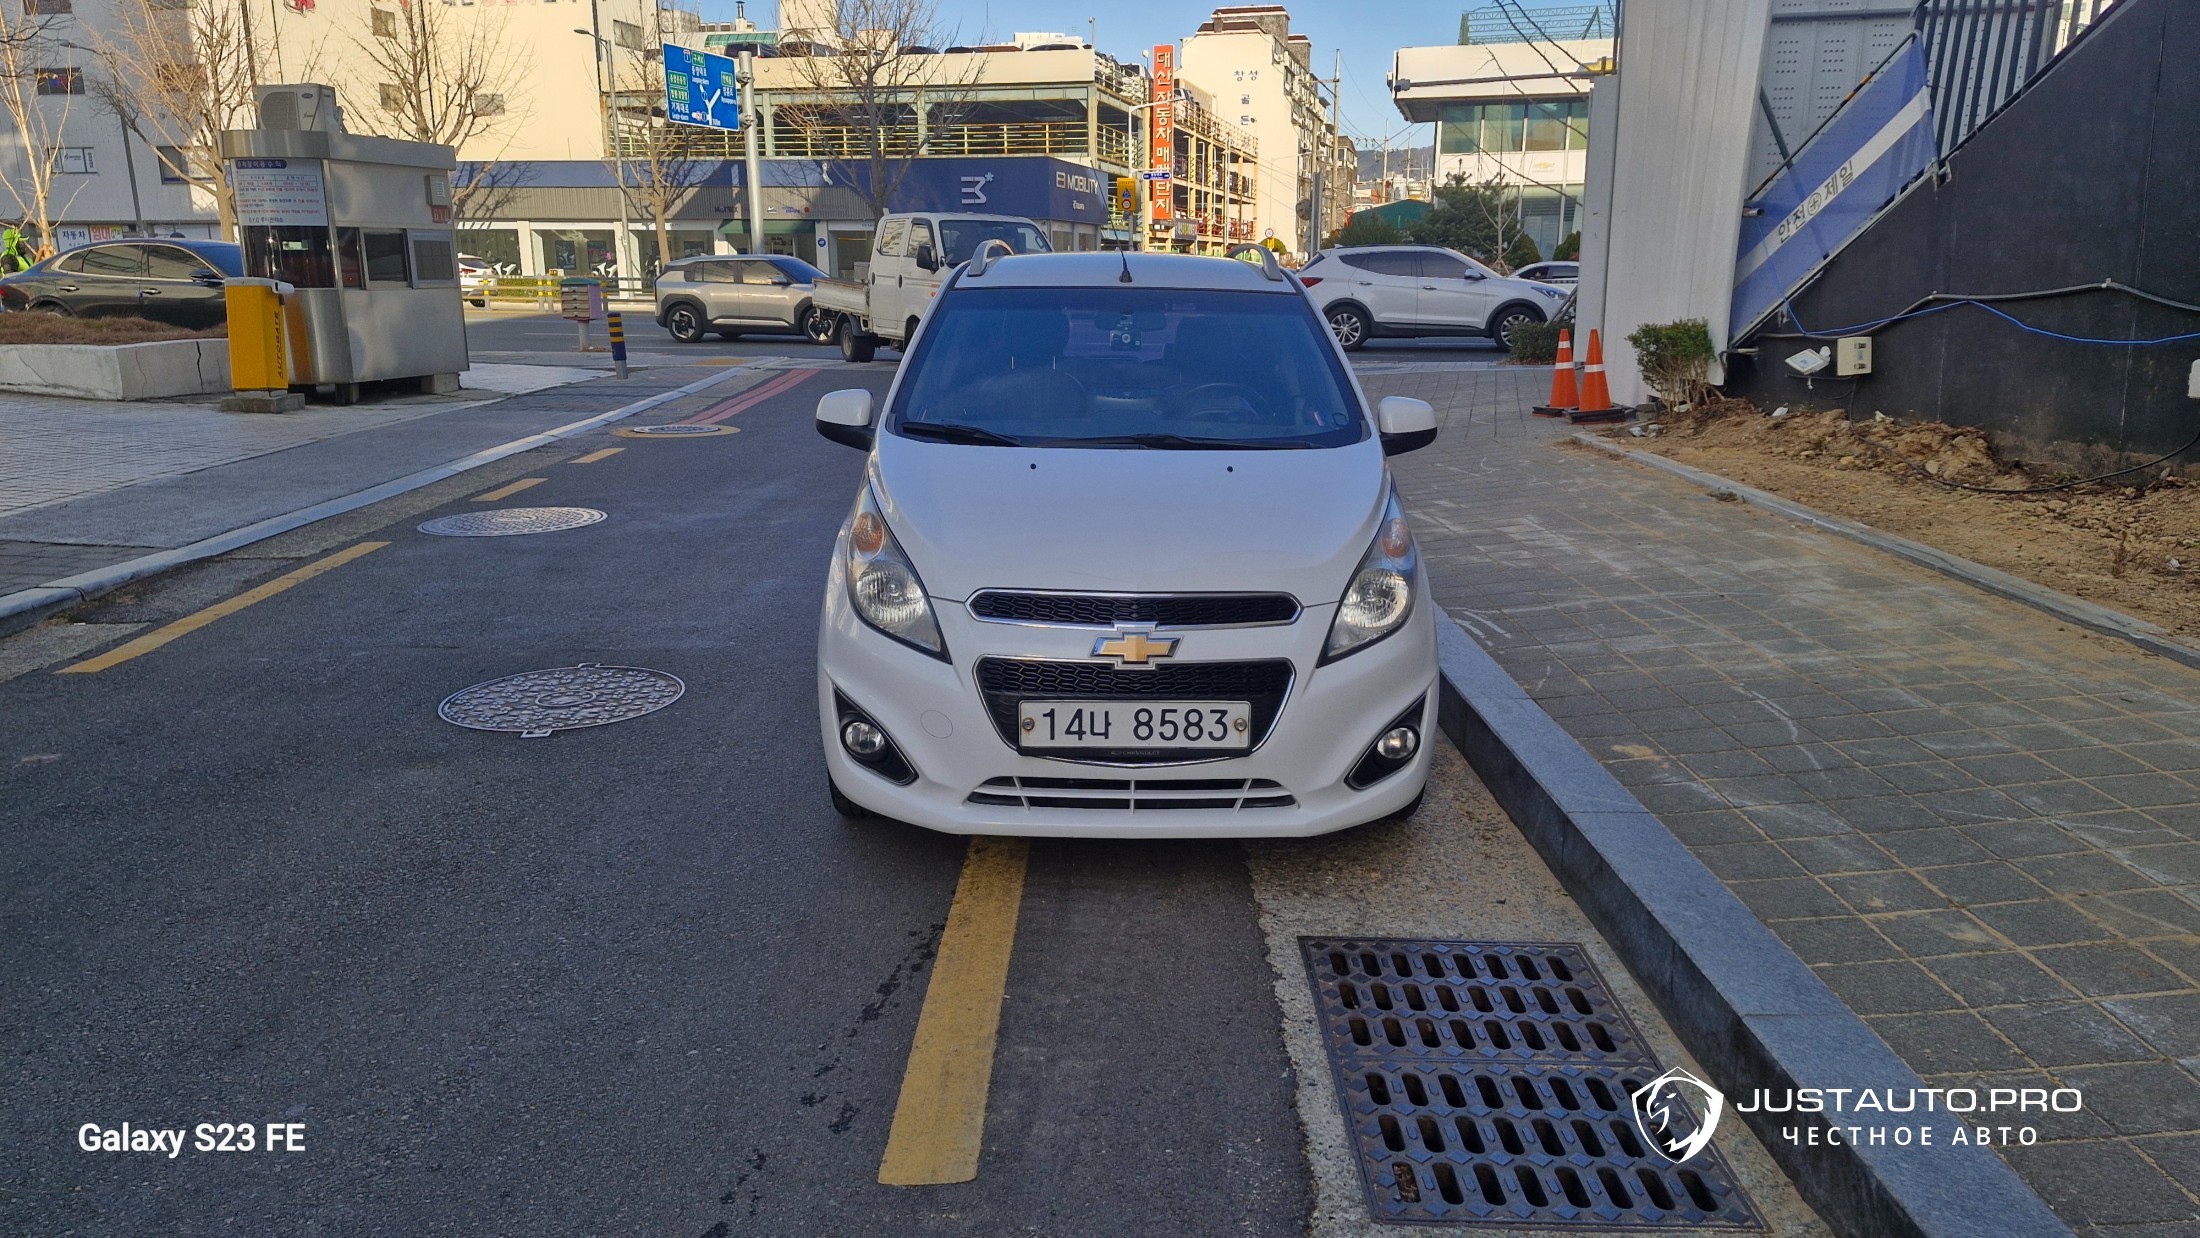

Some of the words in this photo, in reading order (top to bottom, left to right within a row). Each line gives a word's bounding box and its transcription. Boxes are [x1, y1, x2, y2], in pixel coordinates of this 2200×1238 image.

[1156, 52, 1172, 85] 대산
[1156, 91, 1172, 142] 자동차
[1067, 173, 1099, 195] MOBILITY
[1778, 204, 1806, 243] 안전
[1824, 159, 1854, 200] 제일
[63, 230, 86, 240] 자동차
[91, 226, 111, 241] 임대
[274, 310, 284, 380] AUTOGATE
[1042, 708, 1112, 741] 14나
[1132, 707, 1229, 742] 8583
